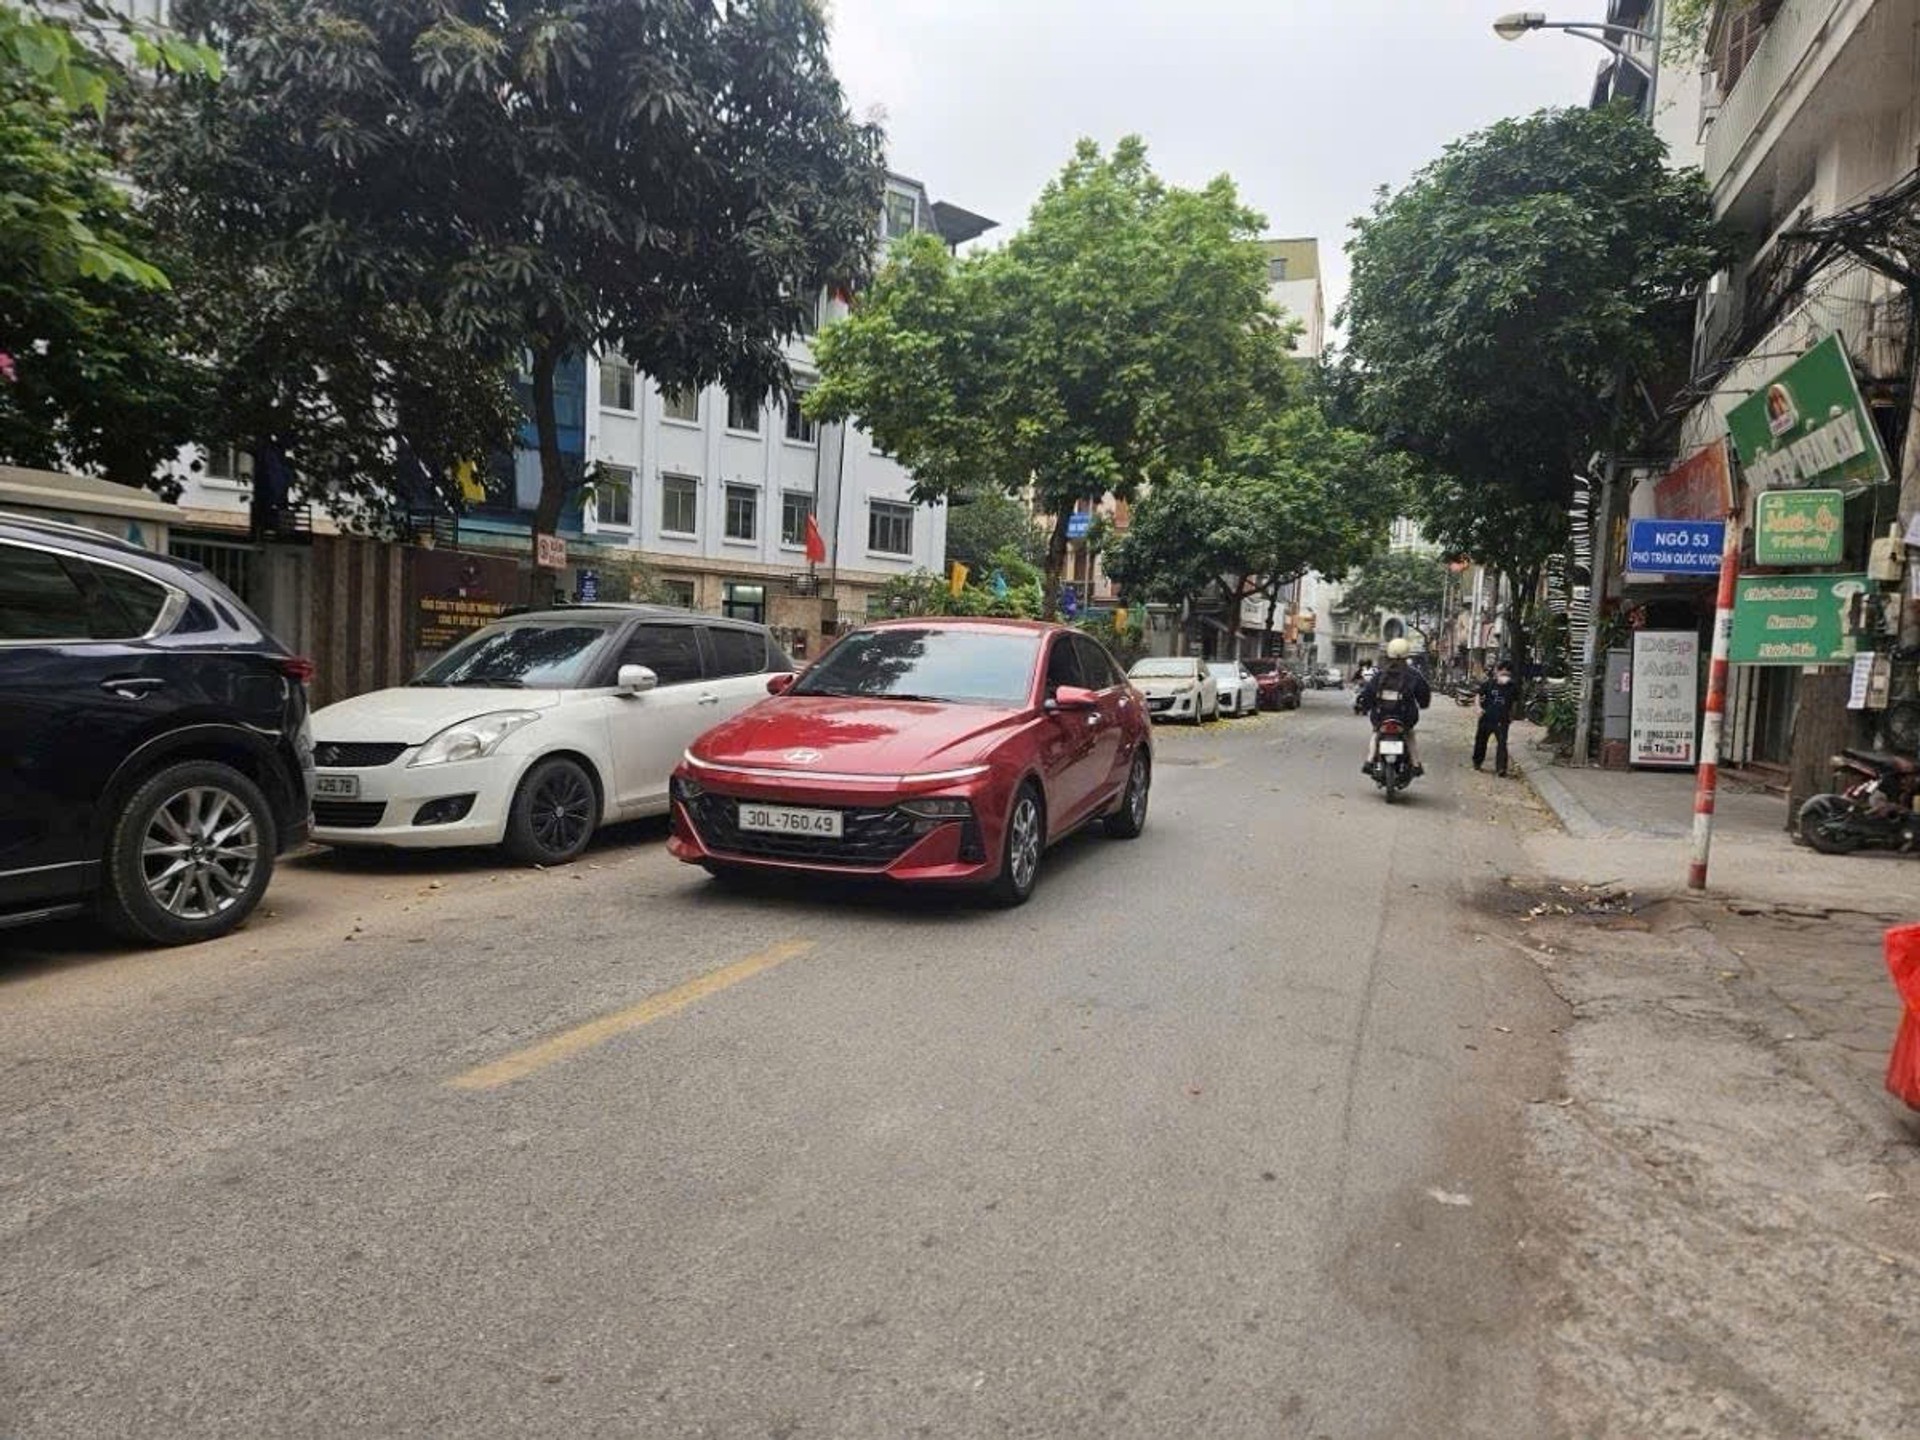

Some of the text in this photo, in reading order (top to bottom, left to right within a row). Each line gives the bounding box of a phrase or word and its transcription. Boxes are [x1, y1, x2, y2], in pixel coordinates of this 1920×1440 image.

[1655, 531, 1709, 547] NGÕ 53
[1632, 551, 1650, 564] PHỐ
[1651, 551, 1671, 564] TRẦN
[1673, 551, 1697, 565] QUỐC
[747, 810, 834, 832] 30L-760.49
